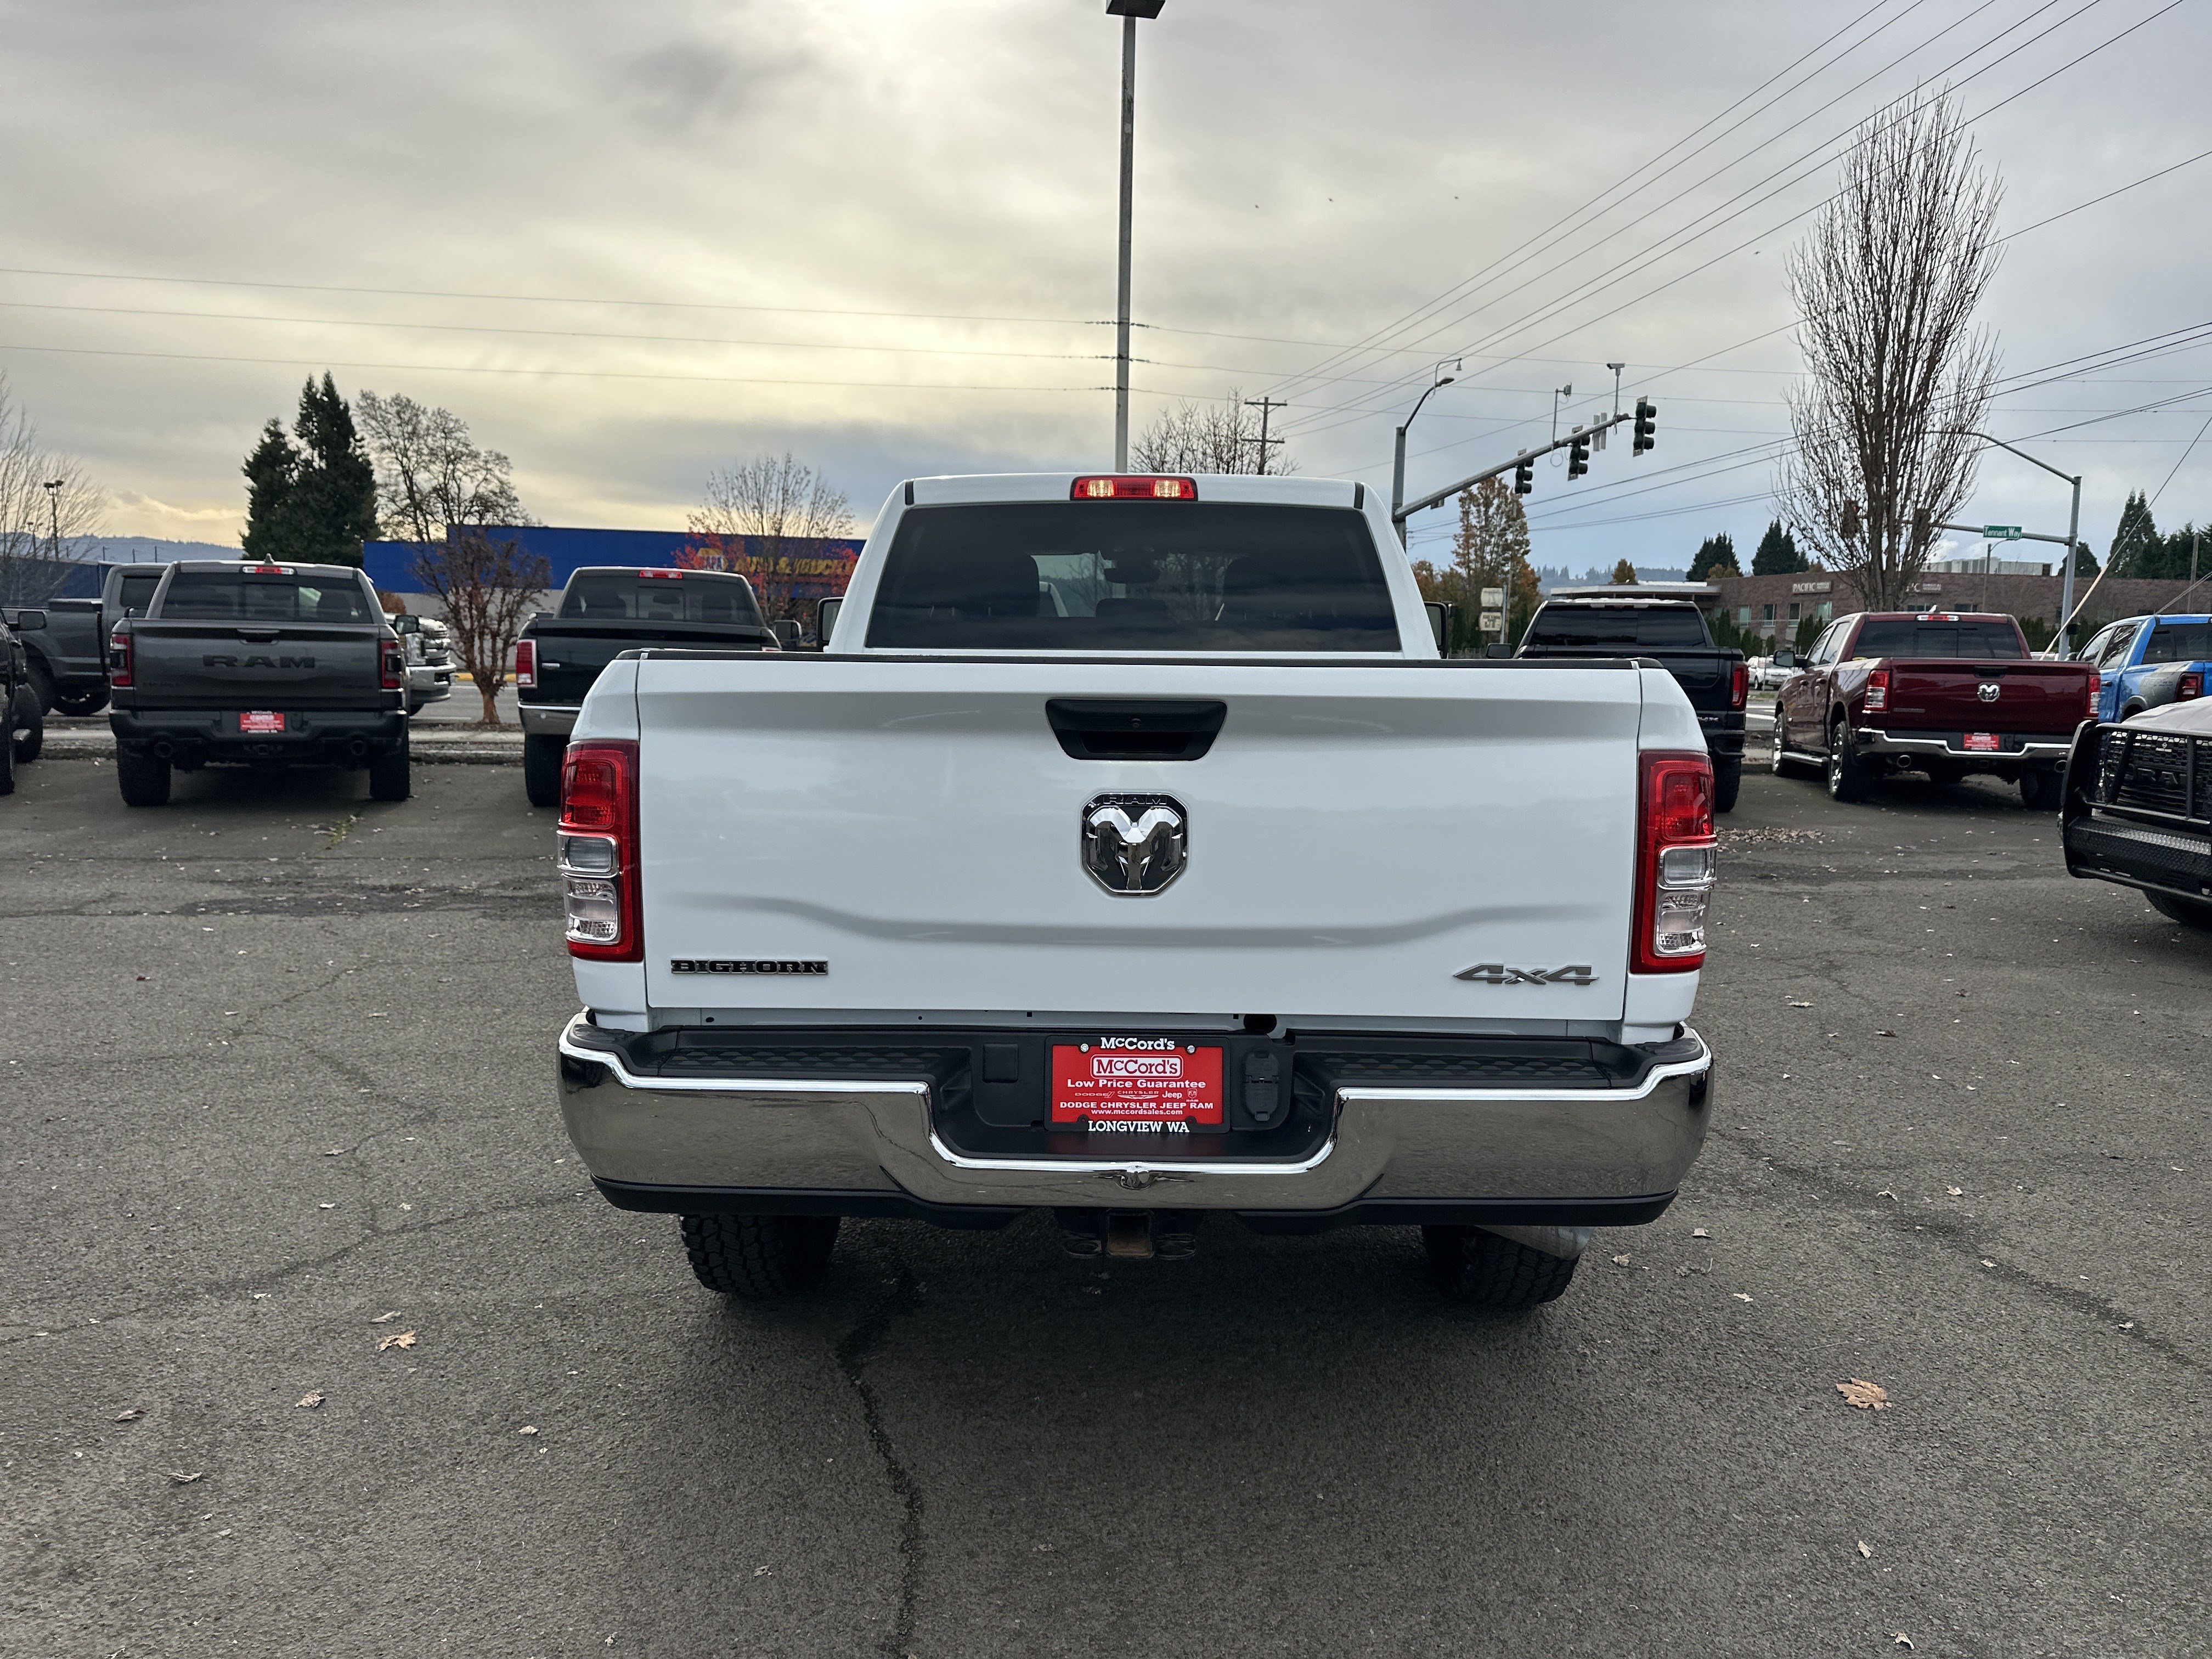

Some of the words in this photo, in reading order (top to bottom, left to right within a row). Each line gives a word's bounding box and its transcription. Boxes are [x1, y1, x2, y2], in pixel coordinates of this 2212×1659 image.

[1984, 526, 2007, 537] Tennant
[2008, 527, 2021, 538] Way
[203, 654, 315, 669] RAM
[1103, 795, 1167, 805] RAM
[1100, 1037, 1175, 1050] McCord's
[1096, 1059, 1178, 1074] McCord's
[1067, 1079, 1094, 1087] Low
[1099, 1079, 1133, 1088] Price
[1137, 1079, 1206, 1088] Guarantee
[1161, 1091, 1183, 1099] Jeep
[1088, 1120, 1163, 1132] LONGVIEW
[1166, 1121, 1190, 1133] WA
